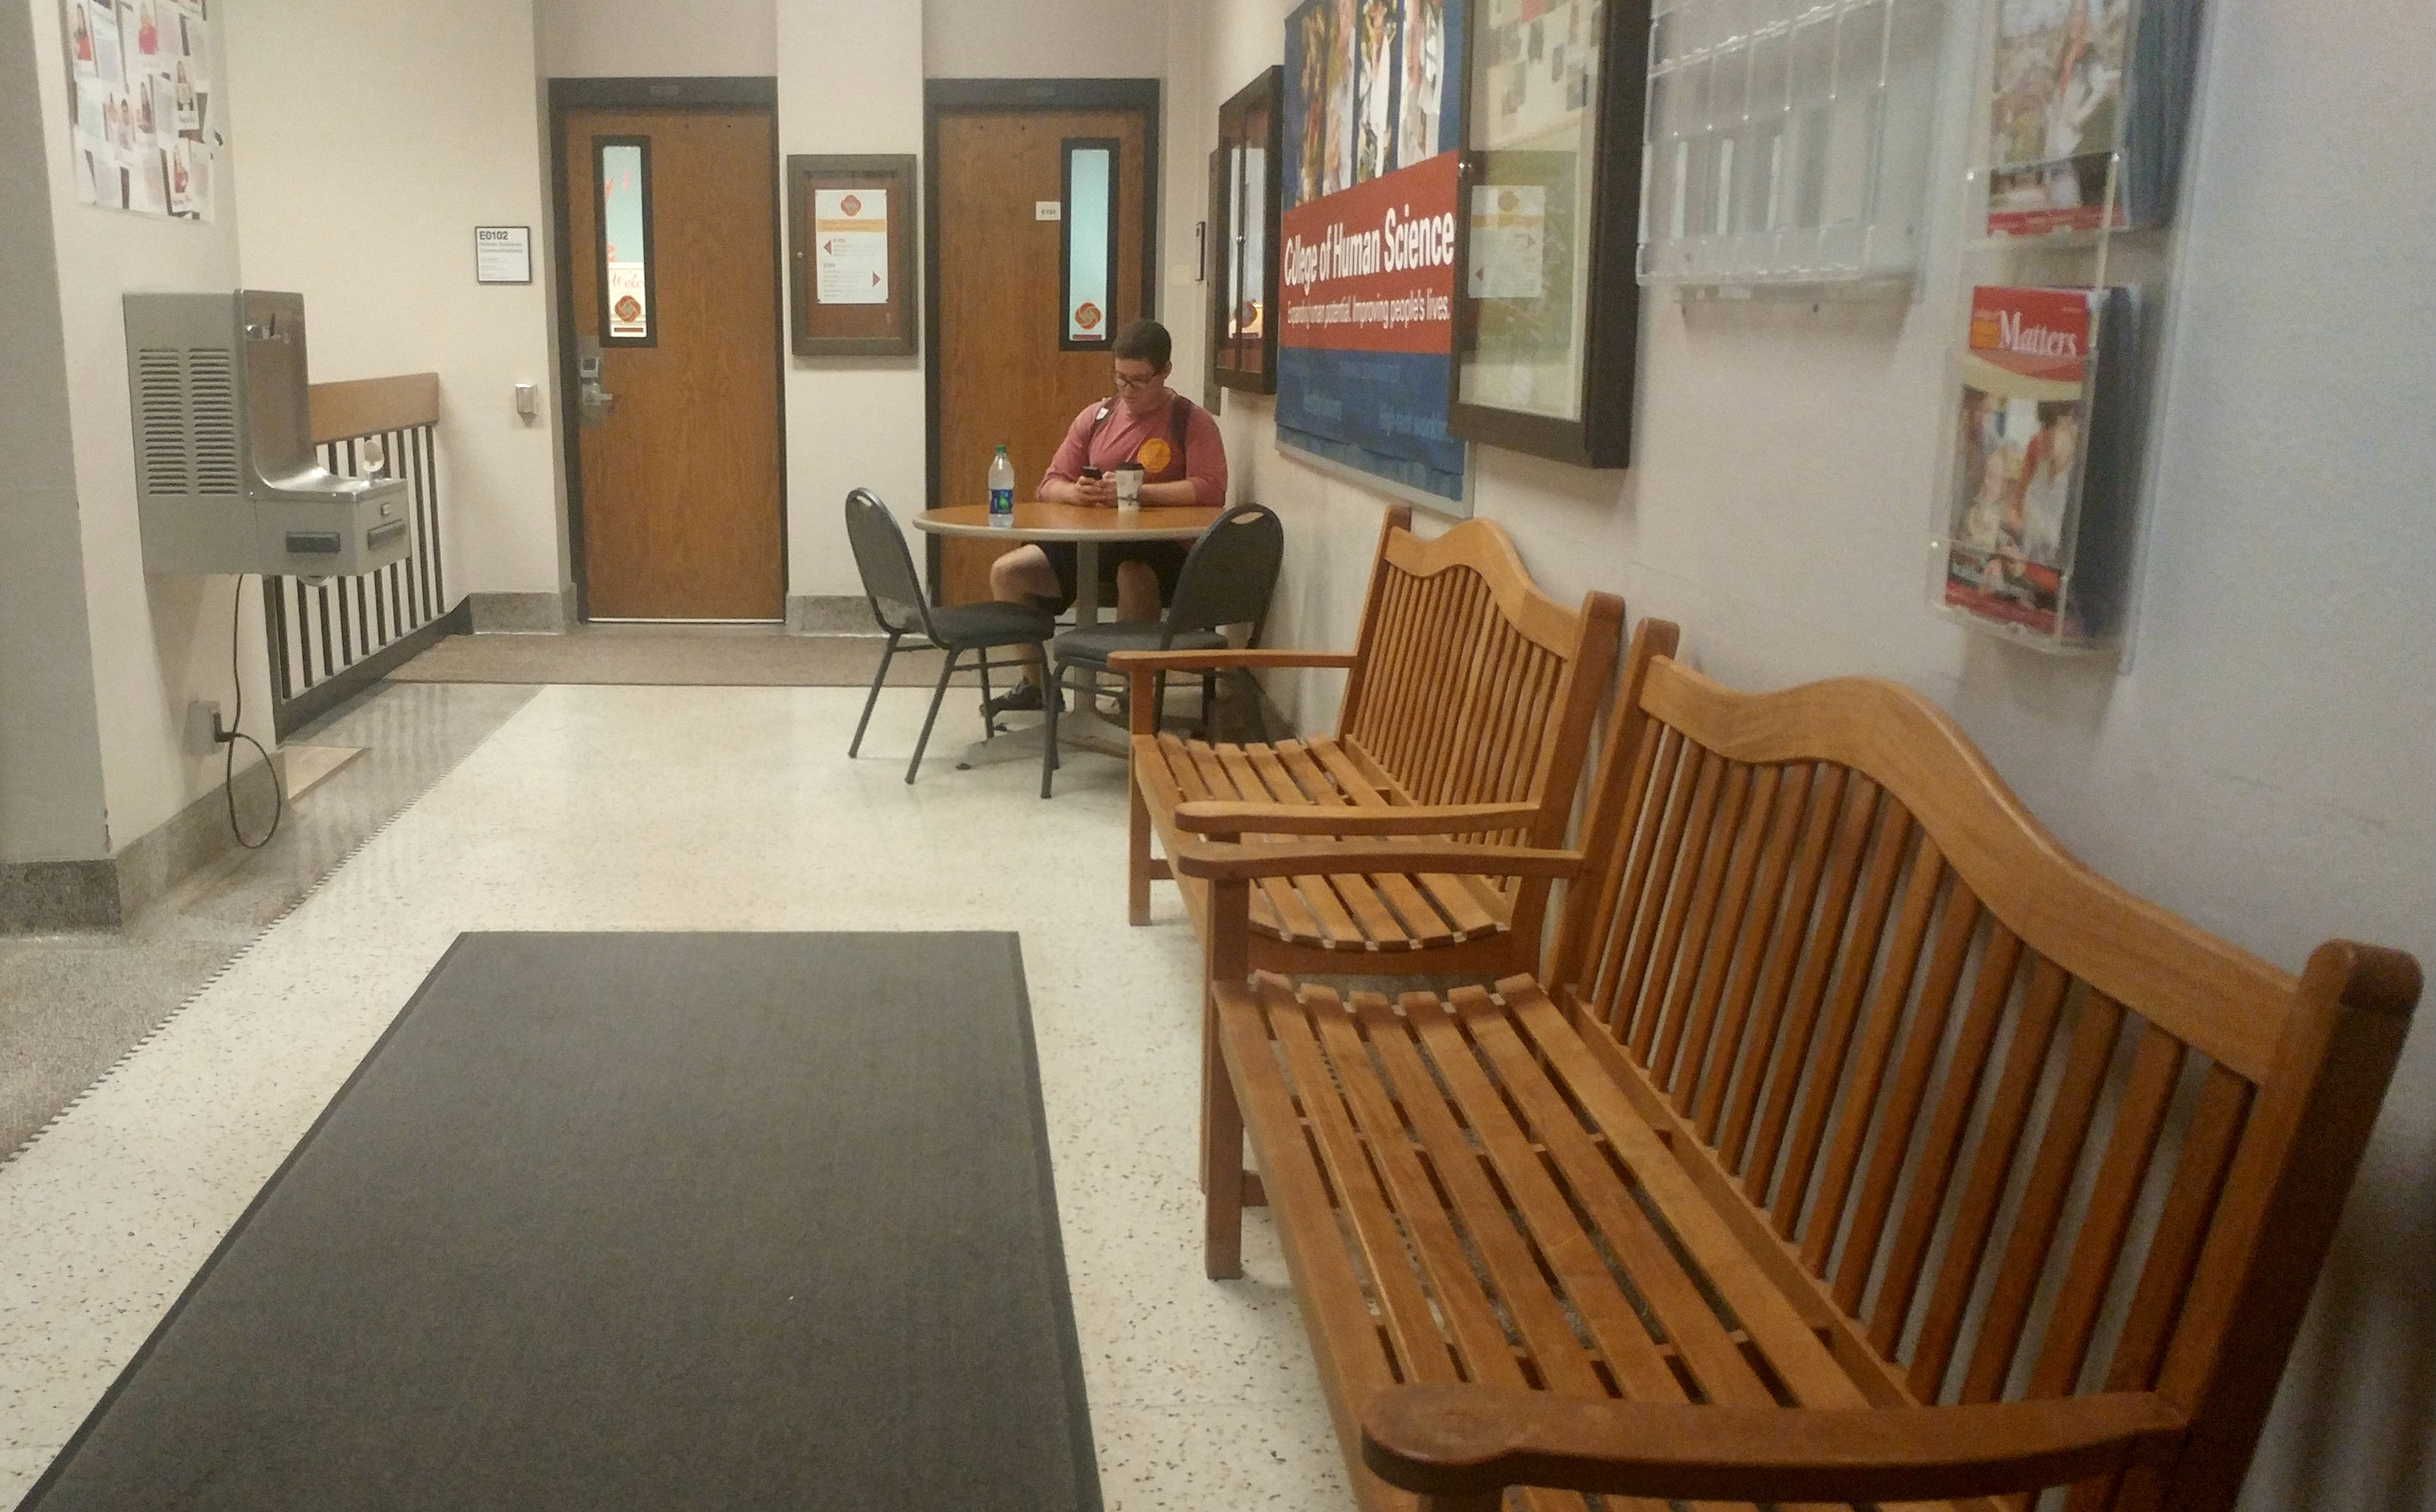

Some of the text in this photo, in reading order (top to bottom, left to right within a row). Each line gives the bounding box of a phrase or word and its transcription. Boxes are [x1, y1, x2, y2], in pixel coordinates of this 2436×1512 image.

[480, 231, 509, 240] E0102
[1284, 203, 1455, 296] College of Human Science
[1390, 289, 1426, 329] people's
[1999, 309, 2077, 360] Matters
